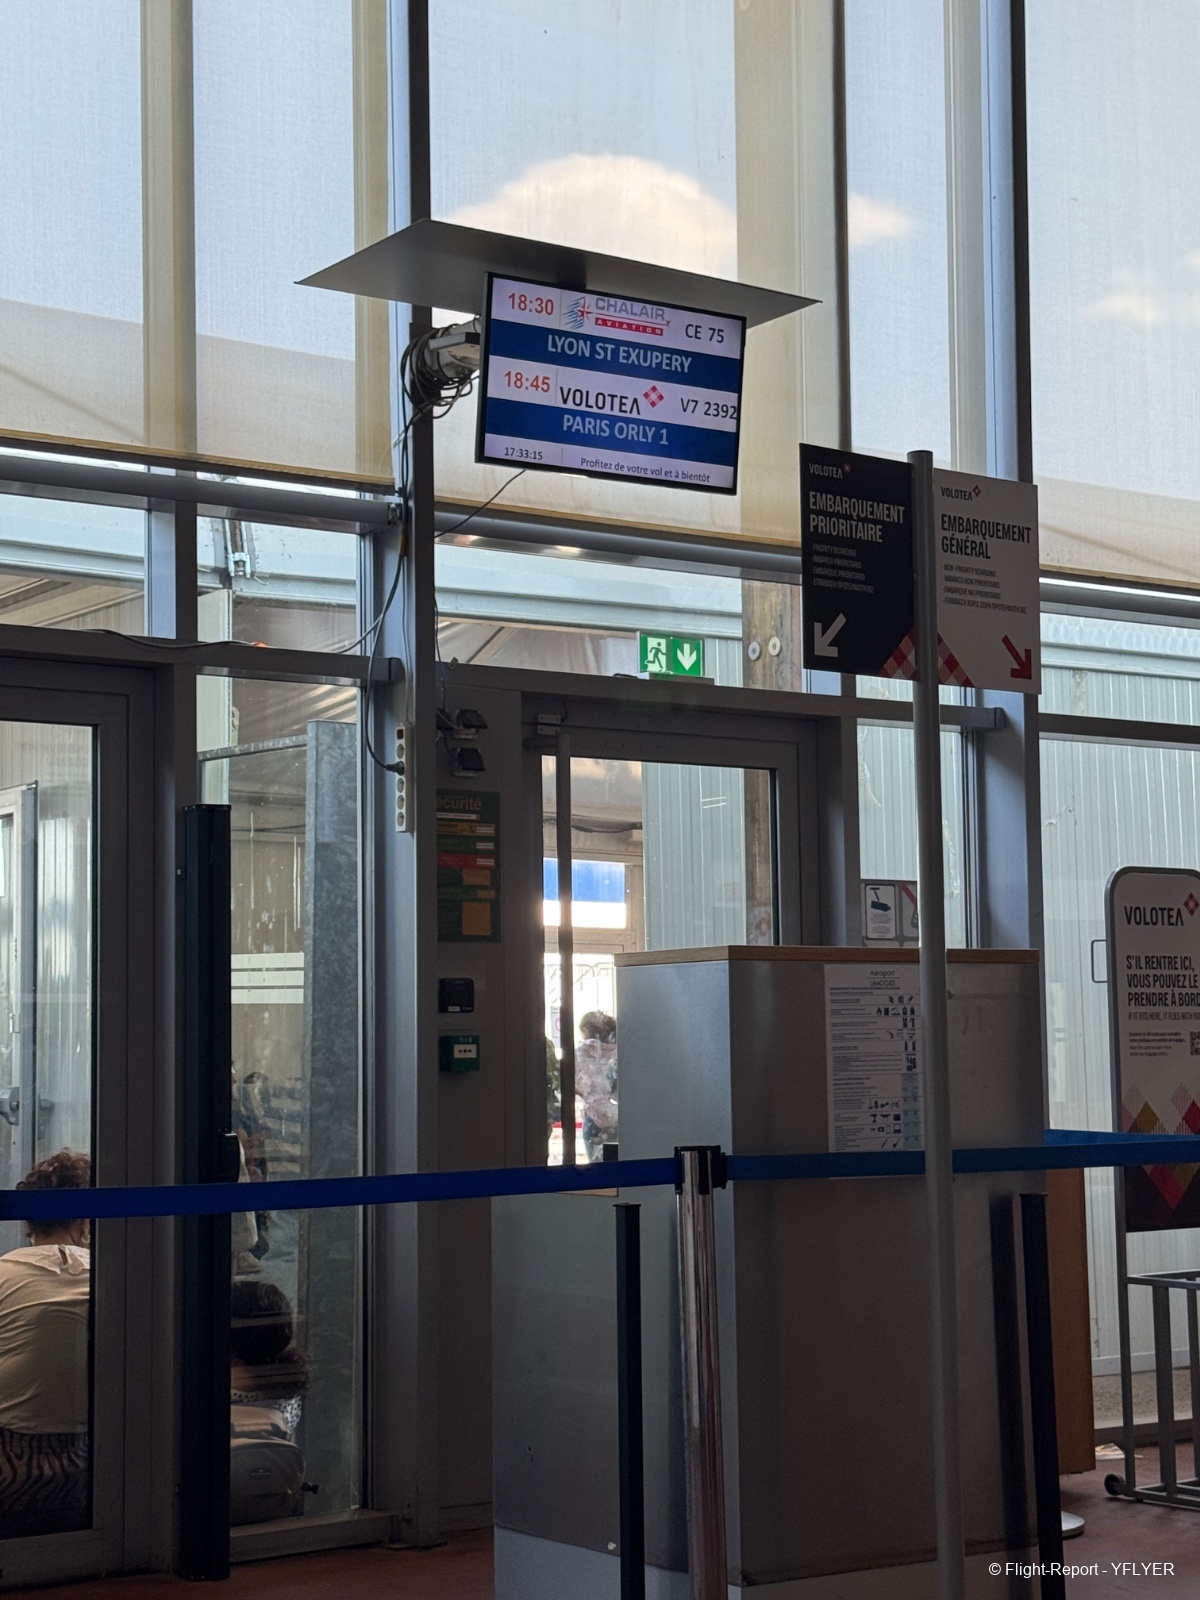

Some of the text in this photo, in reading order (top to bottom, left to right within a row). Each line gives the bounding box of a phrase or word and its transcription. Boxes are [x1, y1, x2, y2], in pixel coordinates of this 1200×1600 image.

[508, 292, 554, 316] 18:30
[595, 297, 665, 321] CHALAIR
[596, 319, 662, 335] AVIATION
[685, 323, 725, 344] CE 75
[547, 334, 693, 374] LYON ST EXUPERY
[504, 370, 551, 393] 18:45
[559, 386, 641, 416] VOLOTEA
[680, 397, 737, 420] V7 2392
[563, 414, 669, 445] PARIS ORLY 1
[504, 446, 544, 461] 17:33:15
[580, 457, 710, 483] Profitez de votre vol et à bientôt
[809, 462, 843, 479] VOLOTEA
[940, 486, 973, 501] VOLOTEA
[809, 490, 905, 524] EMBARQUEMENT
[810, 514, 883, 543] PRIORITAIRE
[941, 513, 1032, 544] EMBARQUEMENT
[941, 535, 991, 560] GÉNÉRAL
[436, 795, 482, 810] écurité
[1124, 905, 1184, 927] VOLOTEA
[1126, 954, 1195, 973] S'IL RENTRE ICI,
[1126, 973, 1198, 989] VOUS POUVEZ LE
[1127, 992, 1169, 1007] PRENDRE
[1170, 989, 1176, 1007] À
